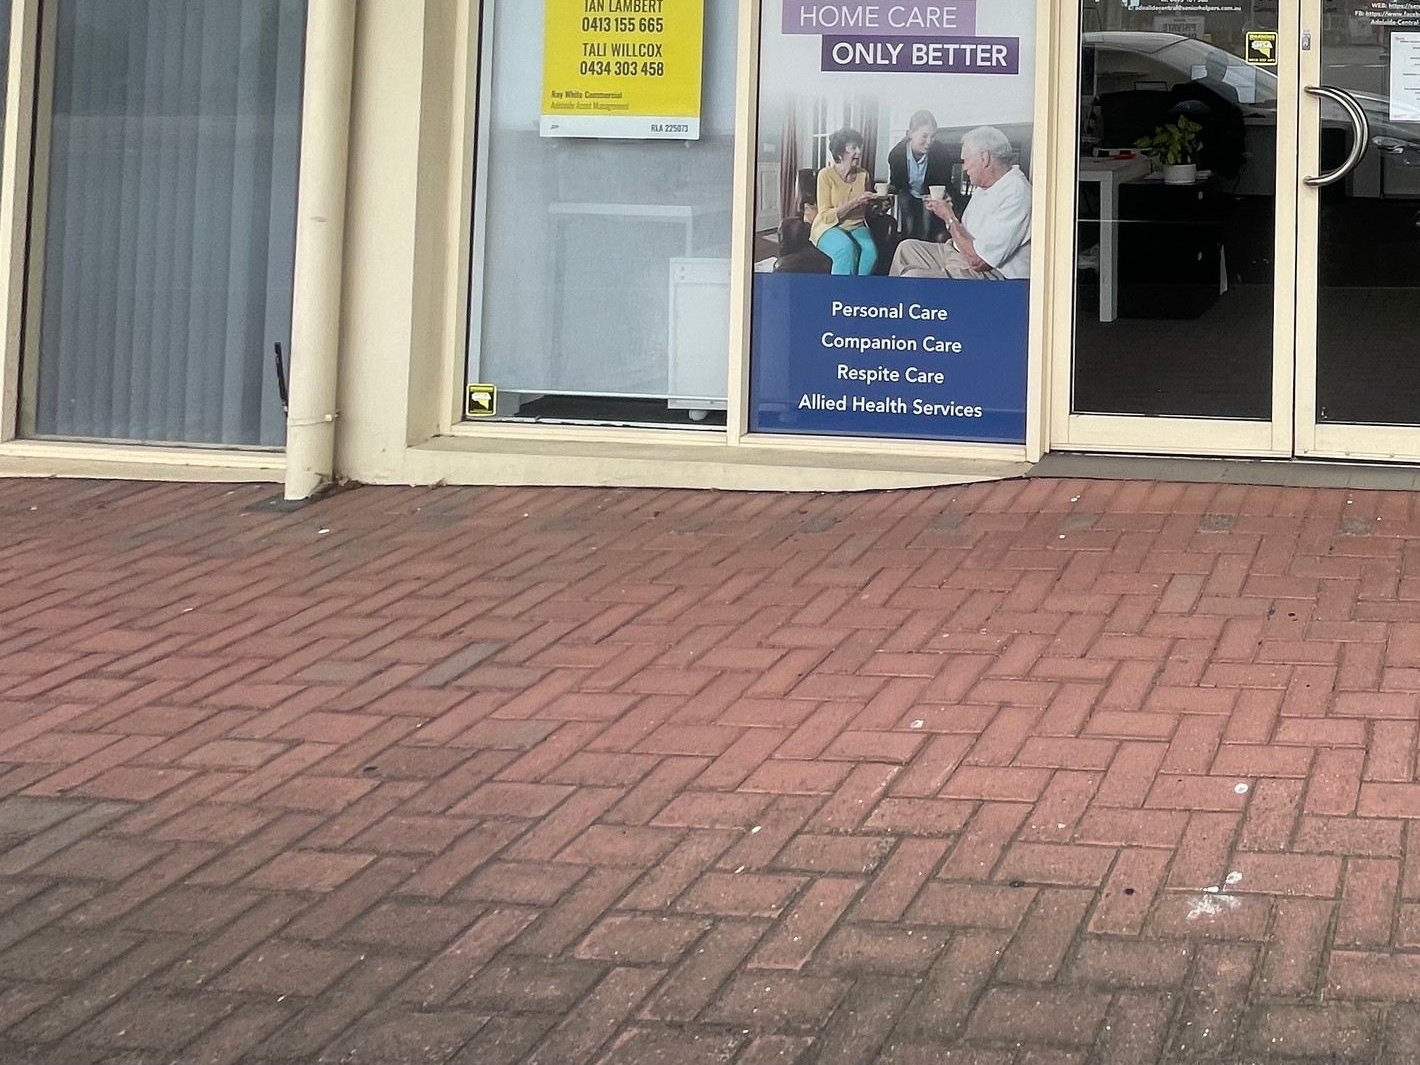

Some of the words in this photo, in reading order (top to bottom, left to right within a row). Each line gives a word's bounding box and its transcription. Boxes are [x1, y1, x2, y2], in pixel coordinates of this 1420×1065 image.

[609, 0, 664, 13] LAMBERT
[582, 17, 610, 32] 0413
[614, 17, 635, 32] 155
[639, 18, 663, 33] 665
[800, 5, 879, 27] HOME
[888, 6, 957, 28] CARE
[582, 43, 607, 57] TALI
[611, 43, 663, 58] WILLCOX
[832, 42, 904, 65] ONLY
[912, 43, 1008, 67] BETTER
[580, 61, 611, 76] 0434
[614, 62, 638, 76] 303
[640, 62, 664, 77] 458
[551, 90, 563, 99] Ray
[565, 90, 582, 99] White
[585, 90, 623, 99] Commercial
[650, 124, 664, 133] RLA
[665, 124, 689, 133] 225073
[832, 301, 903, 319] Personal
[908, 303, 948, 321] Care
[821, 332, 917, 353] Companion
[922, 335, 963, 353] Care
[837, 364, 900, 385] Respite
[905, 367, 945, 384] Care
[798, 394, 848, 412] Allied
[852, 396, 908, 414] Health
[912, 399, 983, 418] Services
